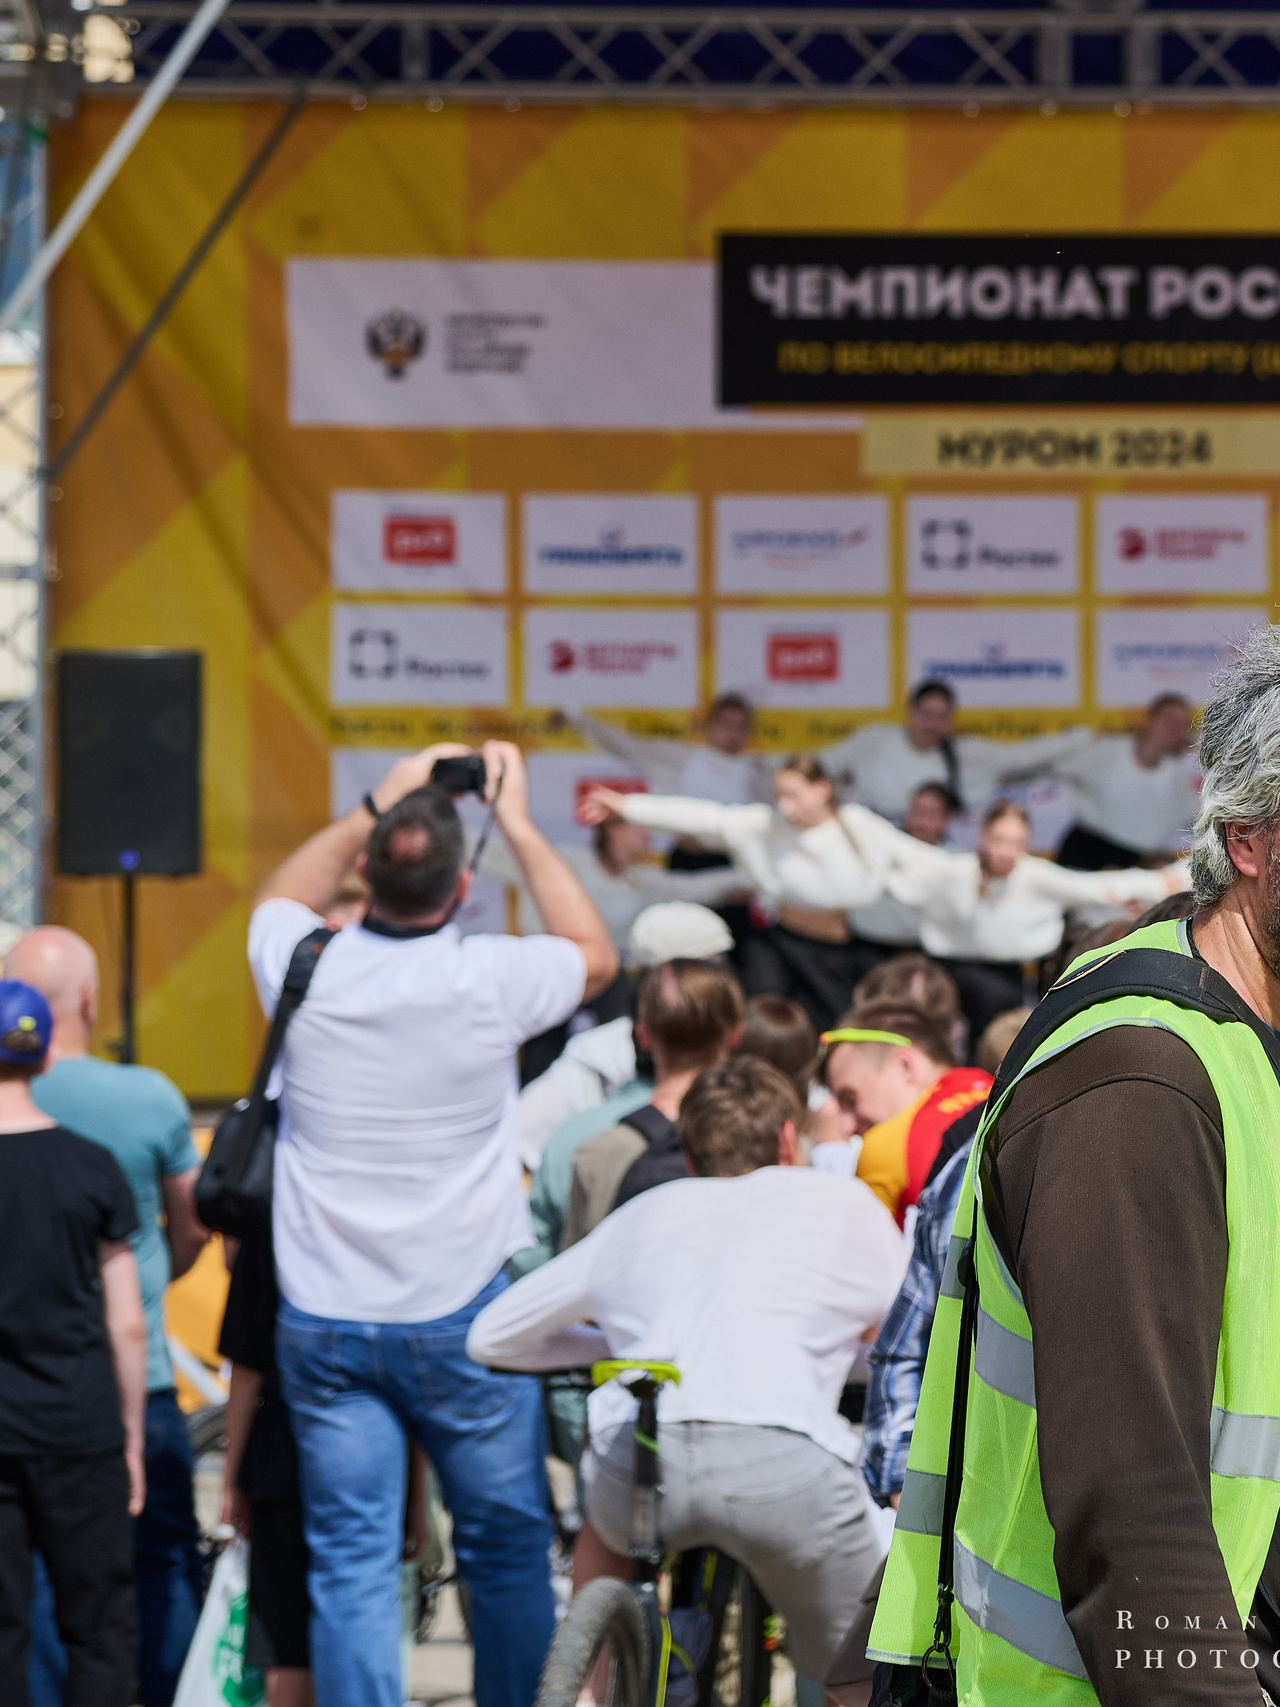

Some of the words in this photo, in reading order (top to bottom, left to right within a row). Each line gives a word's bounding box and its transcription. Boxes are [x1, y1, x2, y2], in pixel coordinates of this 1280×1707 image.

[752, 266, 1137, 319] ЧЕМПИОНАТ
[778, 342, 829, 374] ПО
[834, 342, 1118, 375] ВЕЛОСИПЕДНОМУ
[1121, 342, 1248, 374] СПОРТУ
[938, 431, 1102, 466] МУРОМ
[1112, 431, 1213, 466] 2024
